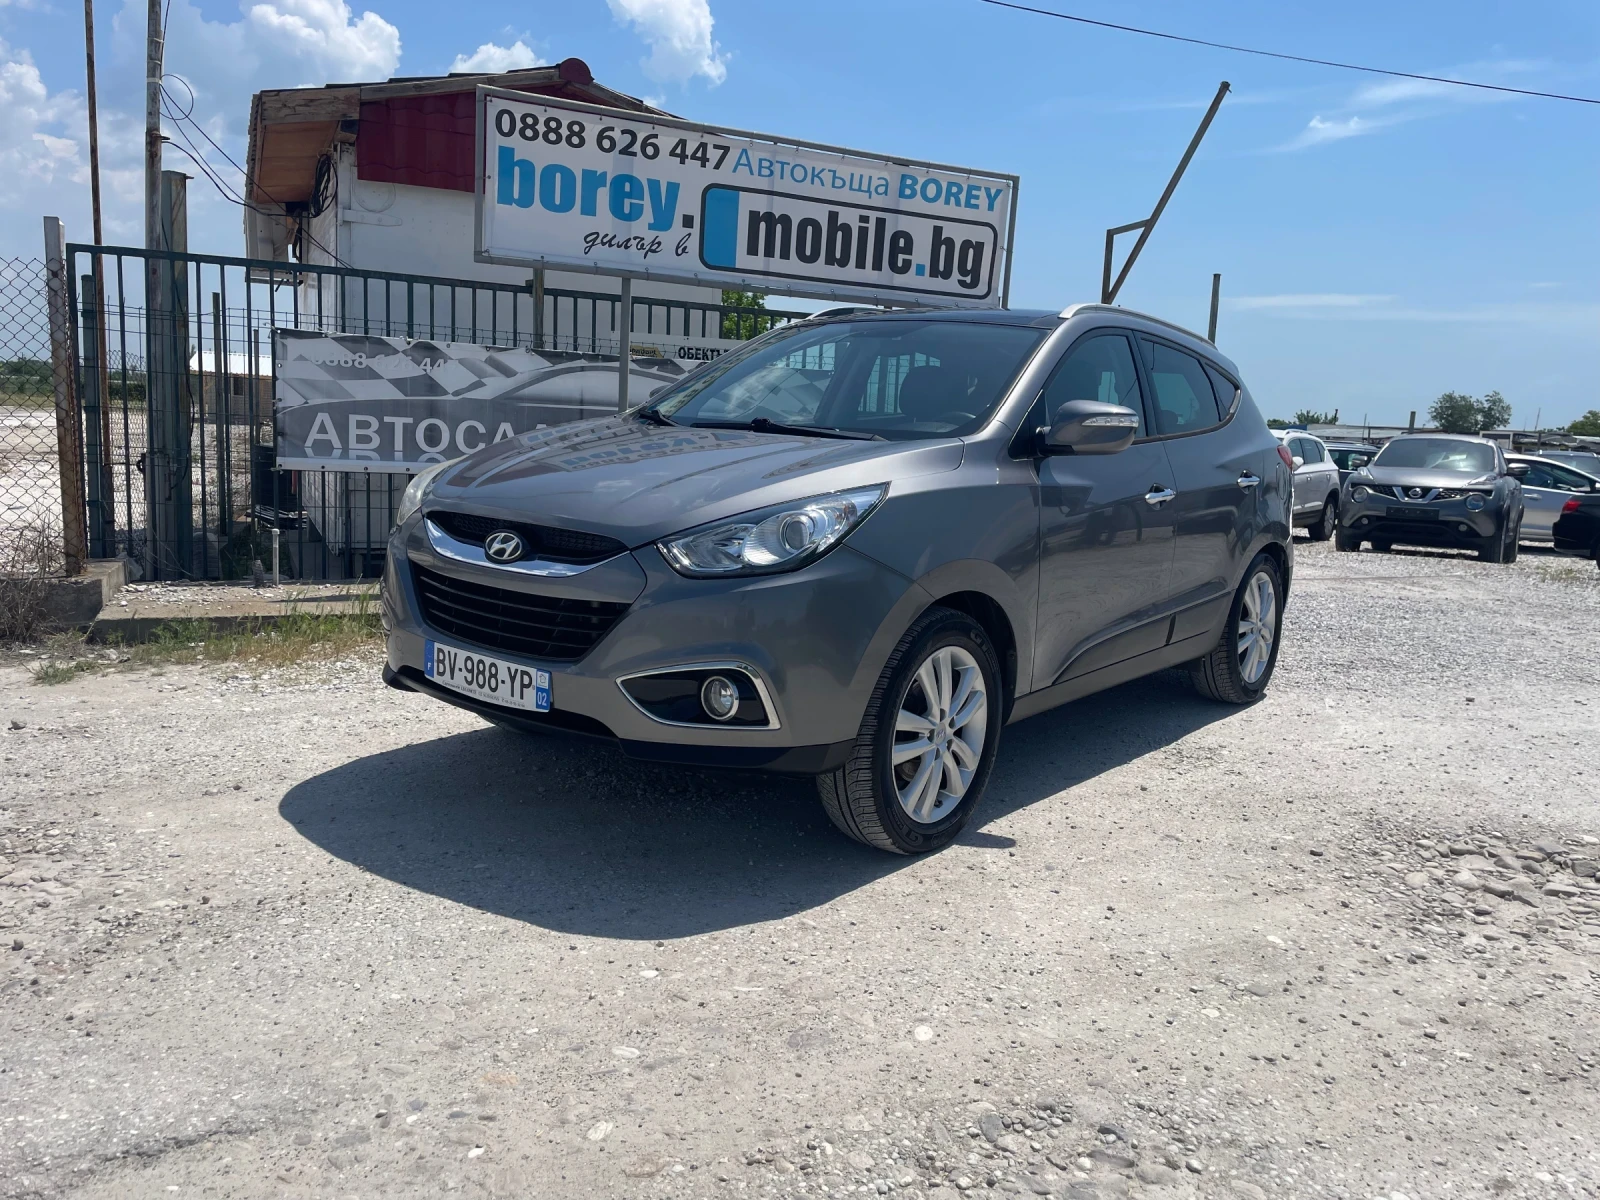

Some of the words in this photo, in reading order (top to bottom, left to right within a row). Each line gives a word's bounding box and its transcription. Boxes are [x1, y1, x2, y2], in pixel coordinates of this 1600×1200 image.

[495, 109, 586, 148] 0888
[596, 126, 660, 160] 626
[668, 138, 731, 171] 447
[898, 173, 1003, 212] BOREY
[746, 209, 986, 289] mobile.bg
[304, 412, 547, 454] АВТОСА
[427, 661, 432, 671] F
[436, 647, 533, 700] BV-988-YP
[537, 691, 547, 706] 02
